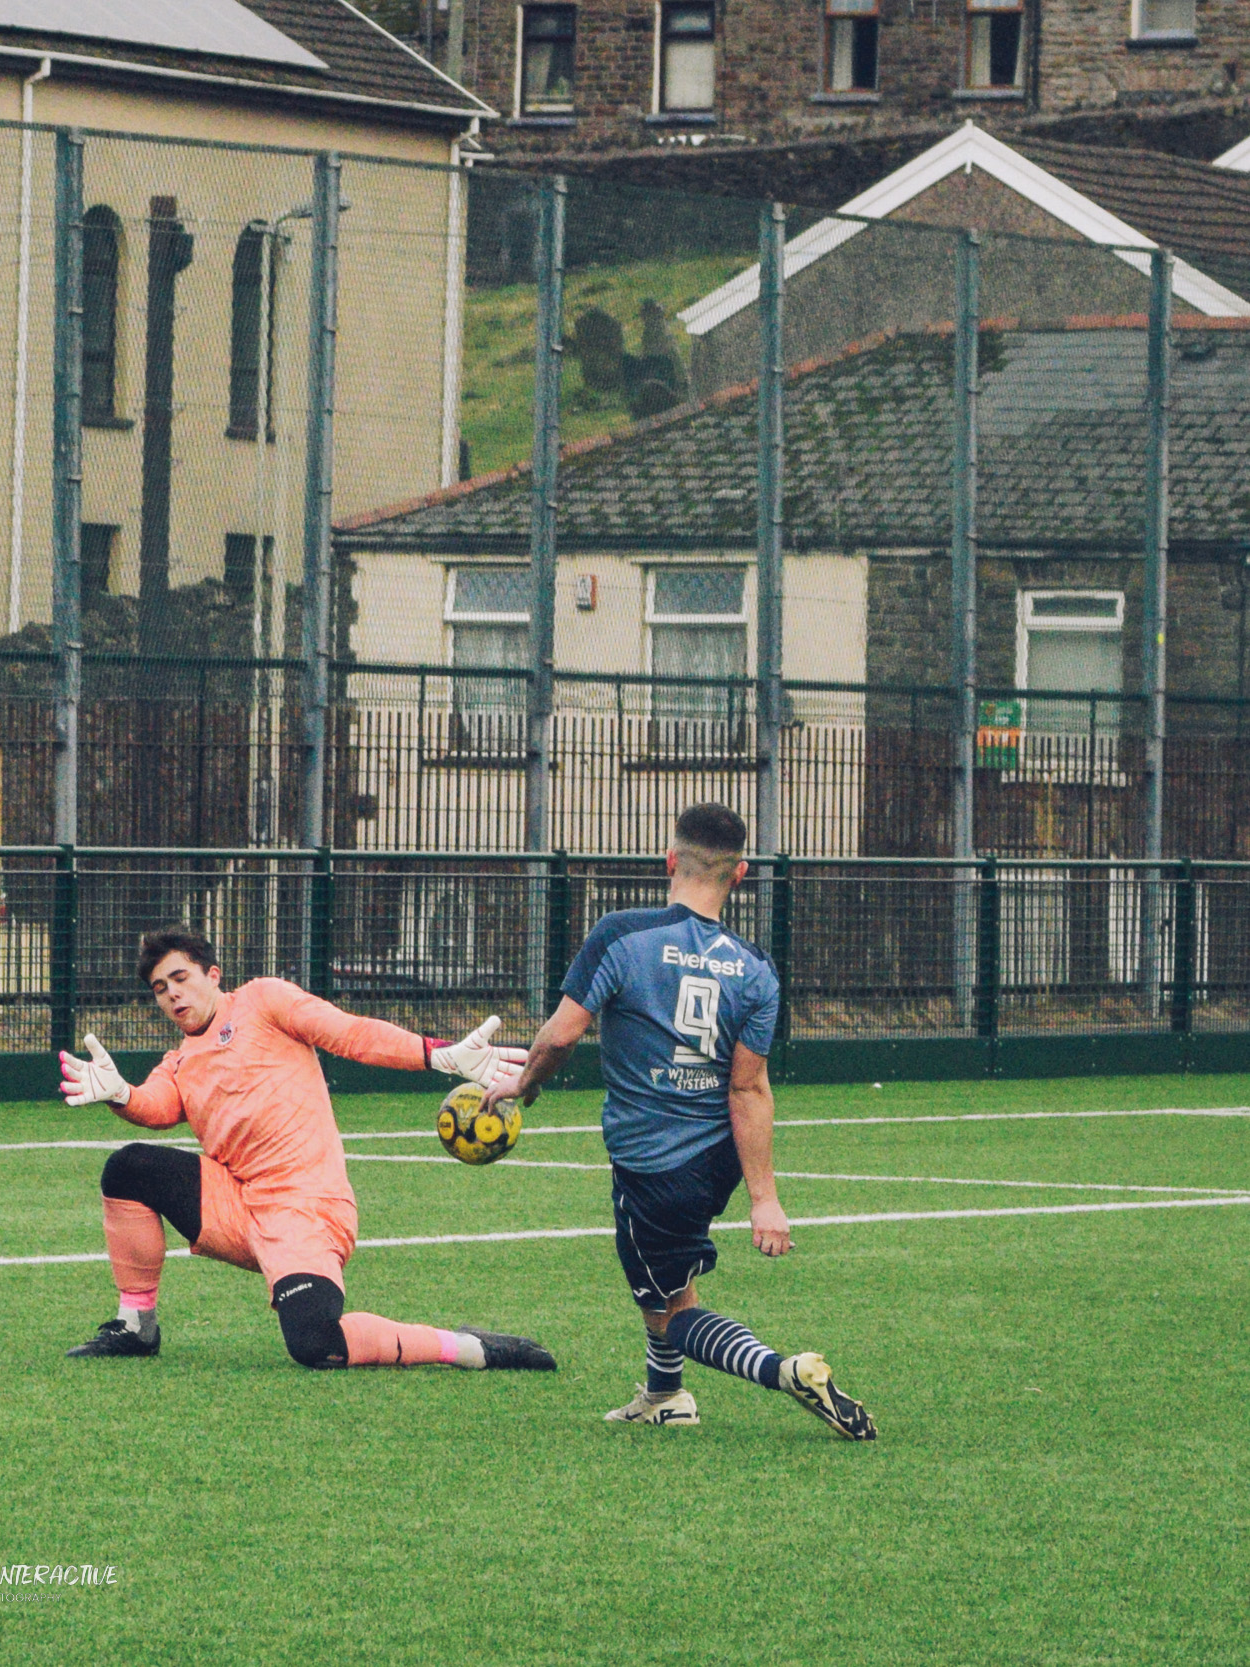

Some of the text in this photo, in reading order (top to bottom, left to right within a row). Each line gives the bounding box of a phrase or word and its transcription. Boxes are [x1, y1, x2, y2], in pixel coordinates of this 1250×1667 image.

[662, 944, 745, 977] Everest
[673, 975, 721, 1063] 9
[676, 1076, 719, 1090] SYSTEMS
